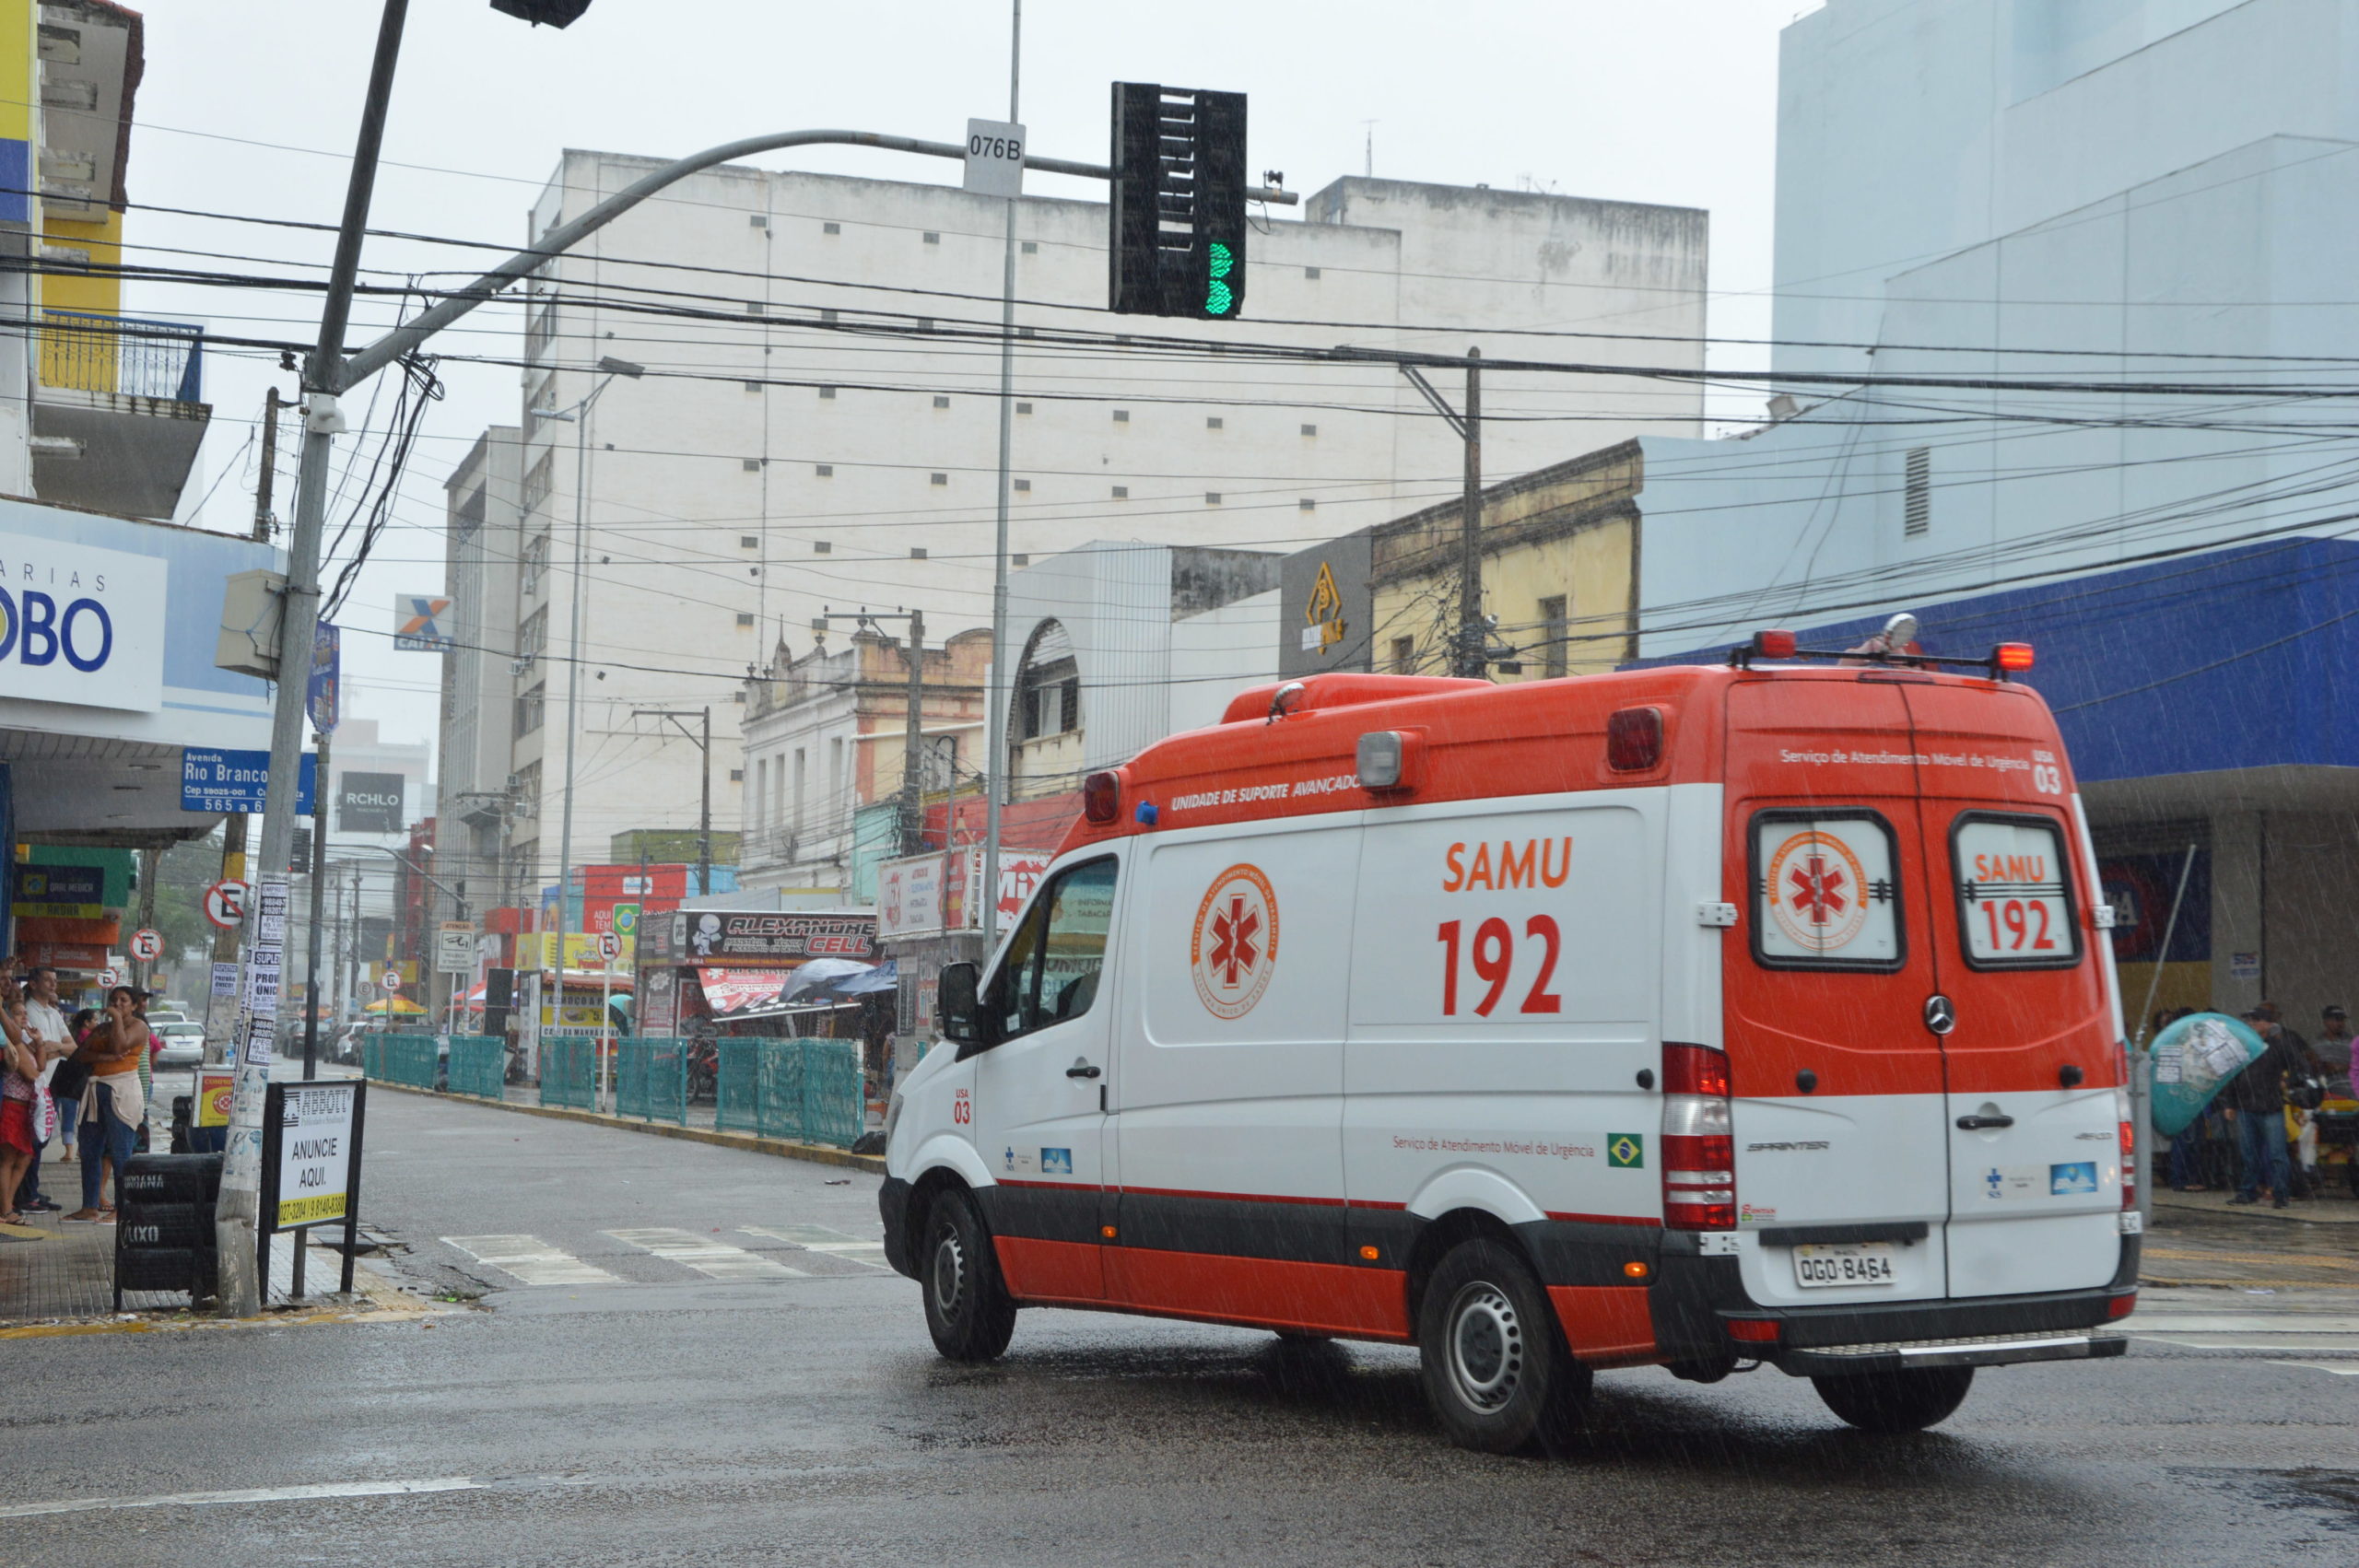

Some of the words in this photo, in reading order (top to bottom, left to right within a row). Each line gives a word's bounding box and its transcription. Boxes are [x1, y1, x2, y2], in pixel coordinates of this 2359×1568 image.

[970, 135, 1021, 160] 076B
[396, 638, 450, 650] CAIXA
[186, 752, 222, 763] Avenida
[1780, 749, 1829, 766] Serviço
[1831, 751, 1847, 763] de
[1850, 751, 1930, 765] Atendimento
[1932, 752, 1967, 766] Móvel
[1971, 754, 1984, 766] de
[1988, 755, 2030, 772] Urgência
[2032, 750, 2055, 764] USA
[185, 762, 207, 780] Rio
[216, 764, 268, 782] Branco
[2034, 766, 2062, 795] 03
[185, 786, 201, 796] Cep
[346, 793, 399, 806] RCHLO
[1172, 790, 1219, 811] UNIDADE
[1222, 788, 1238, 804] DE
[1238, 783, 1289, 802] SUPORTE
[205, 799, 232, 811] 565
[239, 803, 248, 813] a
[1444, 837, 1573, 893] SAMU
[1975, 854, 2045, 883] SAMU
[593, 910, 612, 920] AQUI
[595, 919, 611, 930] TEM
[1982, 898, 2055, 951] 192
[727, 918, 876, 936] ALEXANDRE
[807, 936, 870, 954] CELL
[1437, 914, 1561, 1018] 192
[301, 1089, 347, 1115] ABBOTT
[956, 1089, 968, 1098] USA
[954, 1101, 970, 1124] 03
[291, 1138, 337, 1161] ANUNCIE
[1392, 1135, 1426, 1151] Serviço
[1428, 1137, 1439, 1150] de
[1441, 1139, 1501, 1153] Atendimento
[1504, 1141, 1534, 1155] Móvel
[1536, 1142, 1548, 1155] de
[1551, 1143, 1594, 1159] Urgência
[1746, 1141, 1830, 1152] SPRINTER
[299, 1166, 326, 1188] AQUI.
